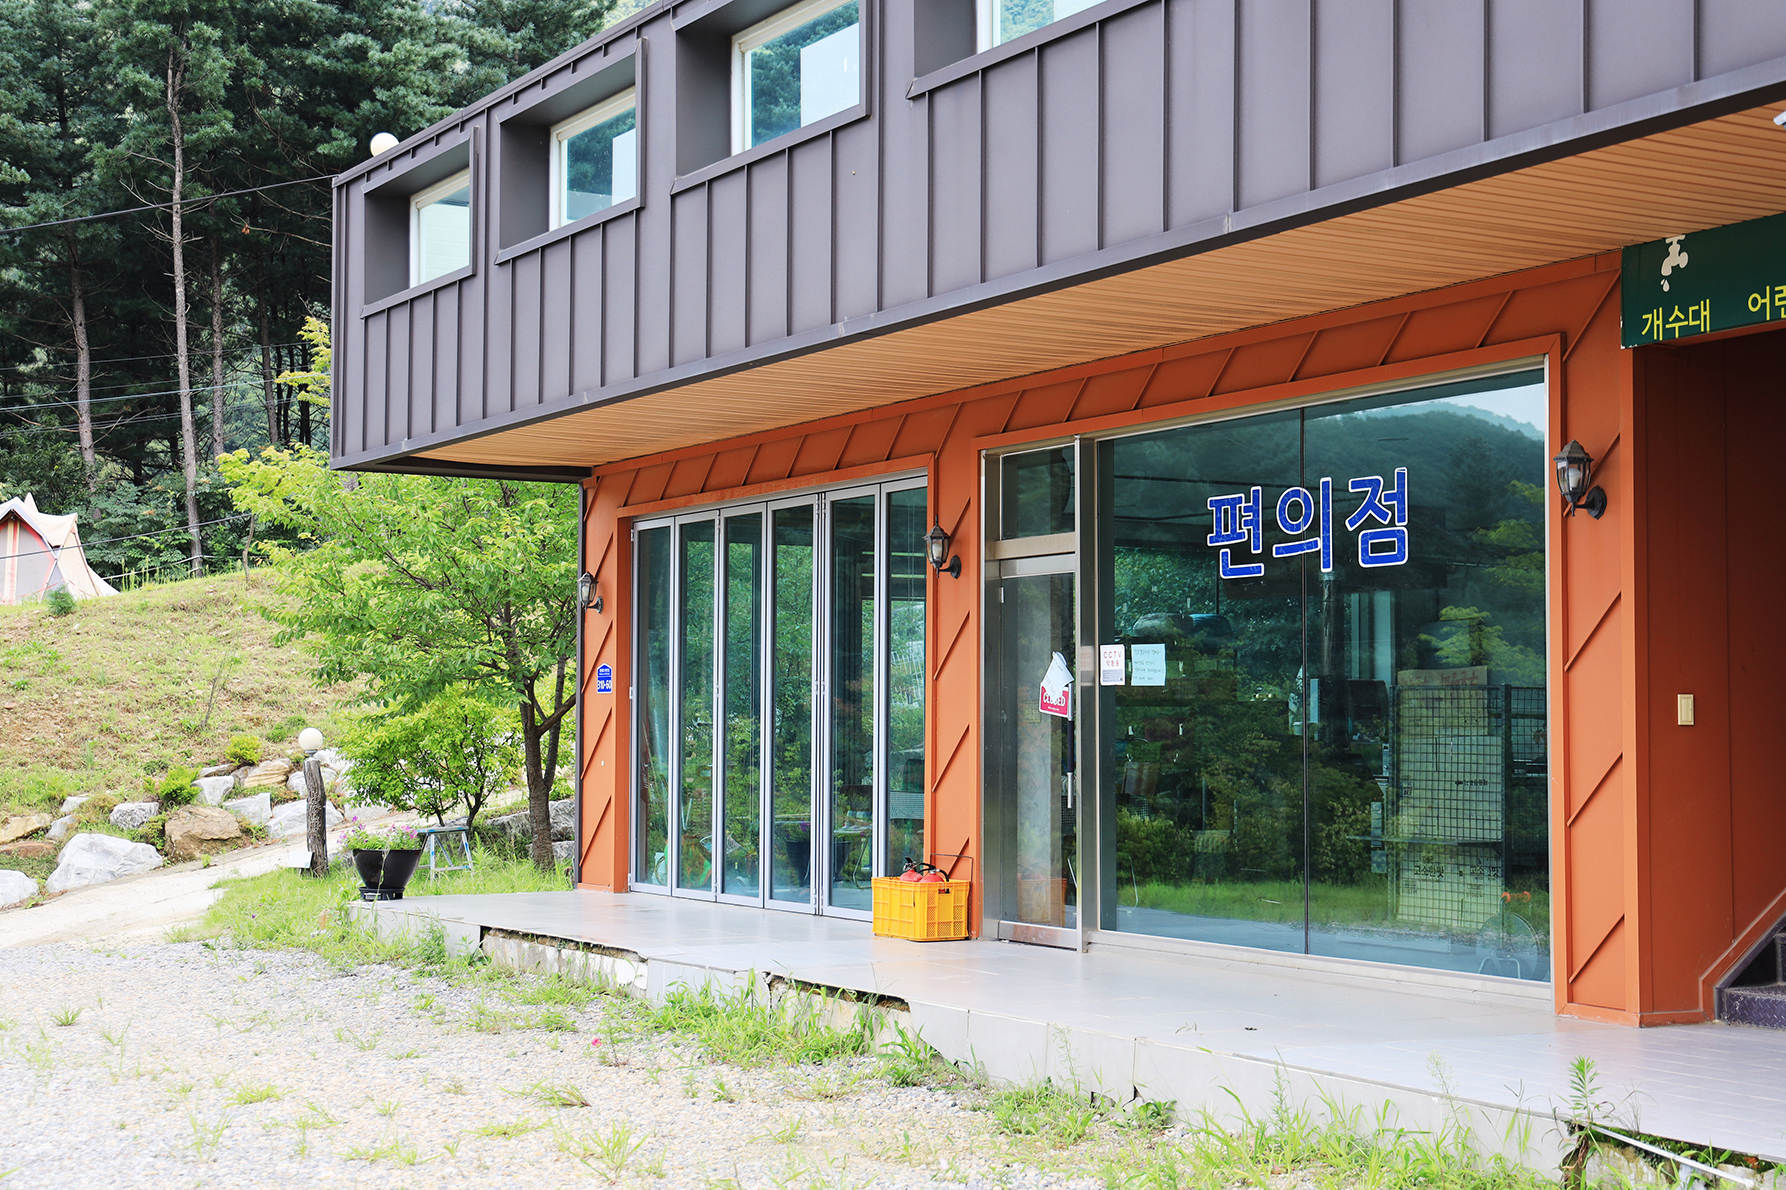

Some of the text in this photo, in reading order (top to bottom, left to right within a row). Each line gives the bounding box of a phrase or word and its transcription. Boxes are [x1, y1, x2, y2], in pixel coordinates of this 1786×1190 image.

[1641, 298, 1710, 341] 개수대
[1207, 467, 1408, 579] 편의점
[1103, 651, 1122, 659] CCTV
[1470, 866, 1499, 877] 고소맛
